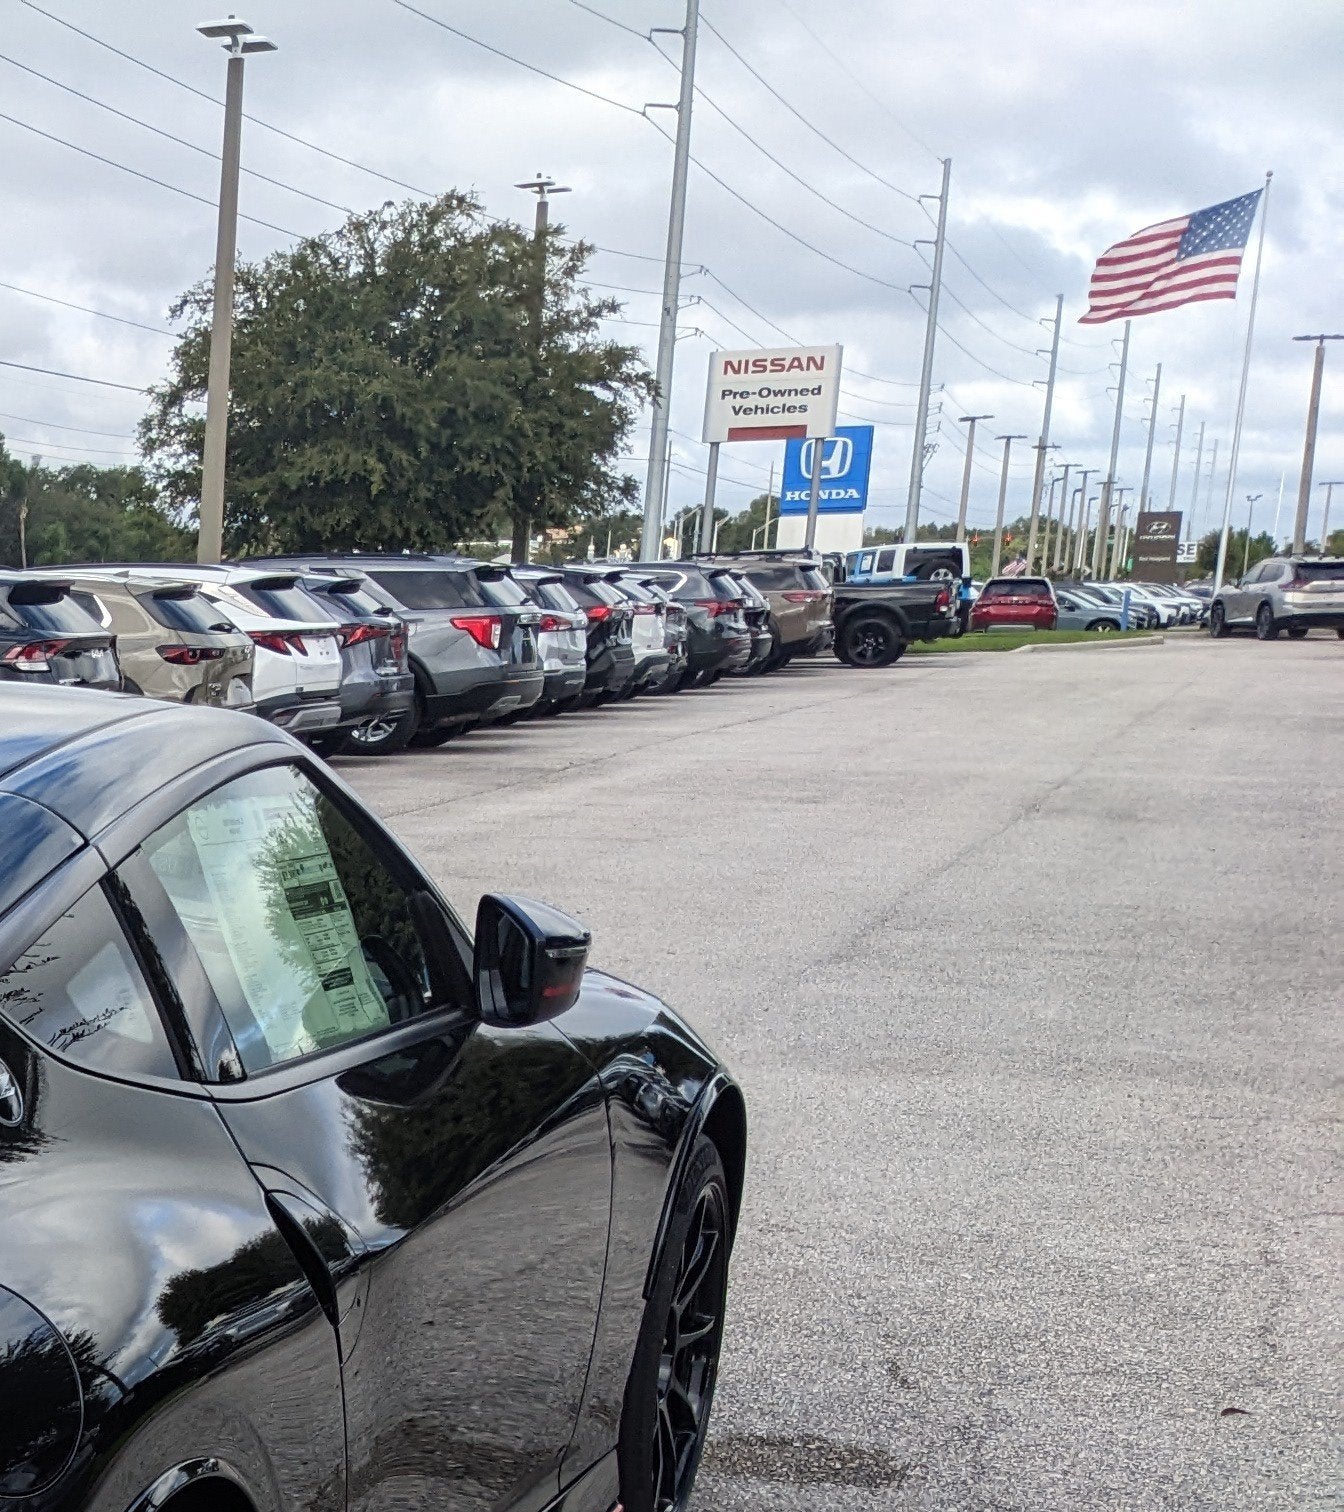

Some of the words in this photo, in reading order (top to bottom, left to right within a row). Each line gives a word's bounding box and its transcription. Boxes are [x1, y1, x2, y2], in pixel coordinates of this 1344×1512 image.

[723, 355, 825, 375] NISSAN
[720, 385, 822, 400] Pre-Owned
[731, 403, 808, 416] Vehicles
